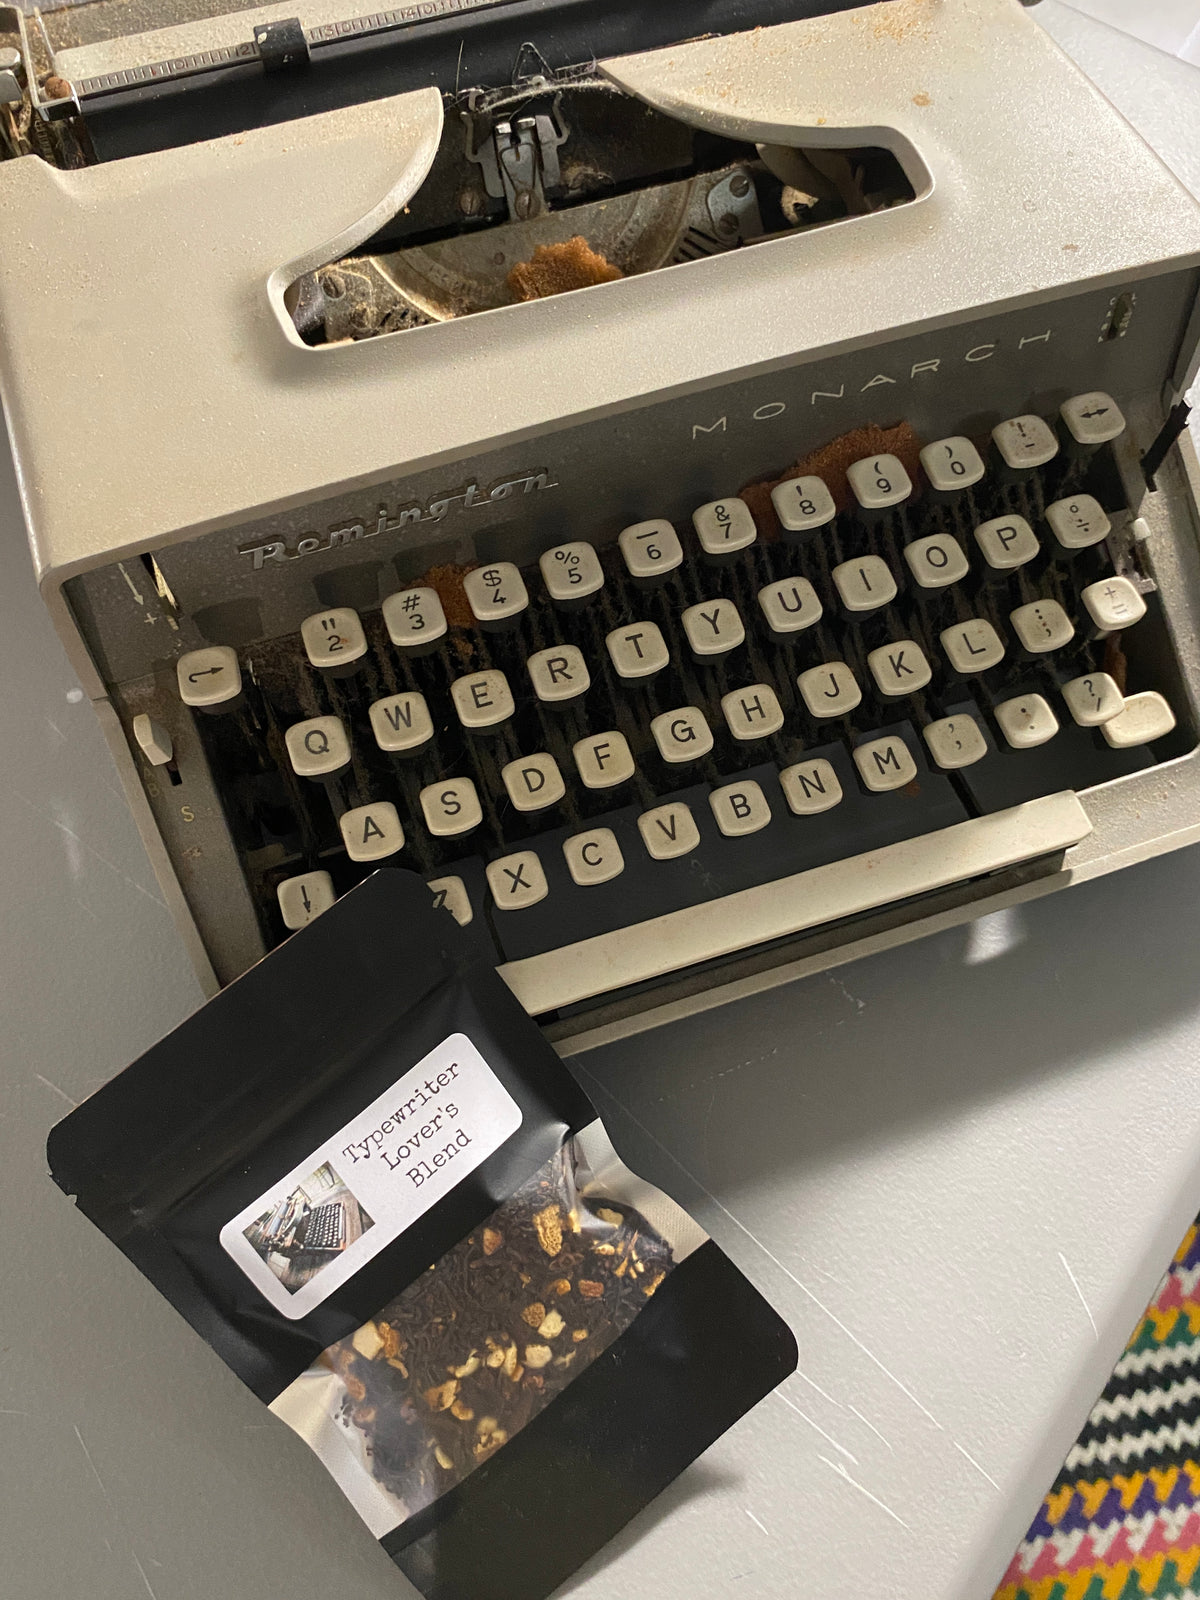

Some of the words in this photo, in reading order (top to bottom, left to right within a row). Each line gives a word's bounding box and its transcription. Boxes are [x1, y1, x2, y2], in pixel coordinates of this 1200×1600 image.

[692, 329, 1051, 440] MONARCH
[876, 478, 892, 494] 9
[238, 468, 559, 569] Remington
[714, 504, 731, 522] &
[799, 499, 817, 515] 8
[719, 522, 732, 539] 7
[995, 526, 1018, 552] P
[554, 550, 580, 565] %
[646, 544, 662, 560] 6
[925, 545, 948, 568] O
[482, 569, 502, 587] $
[567, 567, 583, 585] 5
[858, 568, 872, 592] I
[401, 594, 421, 613] #
[492, 588, 507, 604] 4
[777, 587, 803, 613] U
[408, 613, 425, 630] 3
[699, 608, 721, 635] Y
[326, 634, 344, 652] 2
[624, 632, 644, 659] T
[962, 632, 987, 655] L
[546, 657, 574, 684] R
[888, 650, 914, 678] K
[470, 681, 494, 709] E
[823, 672, 840, 698] J
[383, 701, 412, 731] W
[740, 695, 766, 723] H
[304, 729, 330, 755] Q
[670, 719, 697, 743] G
[593, 742, 611, 771] F
[872, 746, 901, 775] M
[521, 767, 545, 793] D
[797, 769, 826, 799] N
[181, 805, 195, 822] S
[440, 790, 462, 816] S
[728, 793, 752, 819] B
[362, 815, 386, 844] A
[655, 814, 677, 841] V
[581, 842, 603, 867] C
[502, 863, 532, 894] X
[342, 1061, 460, 1164] Typewriter
[380, 1101, 460, 1171] Lover's
[405, 1128, 473, 1189] Blend
